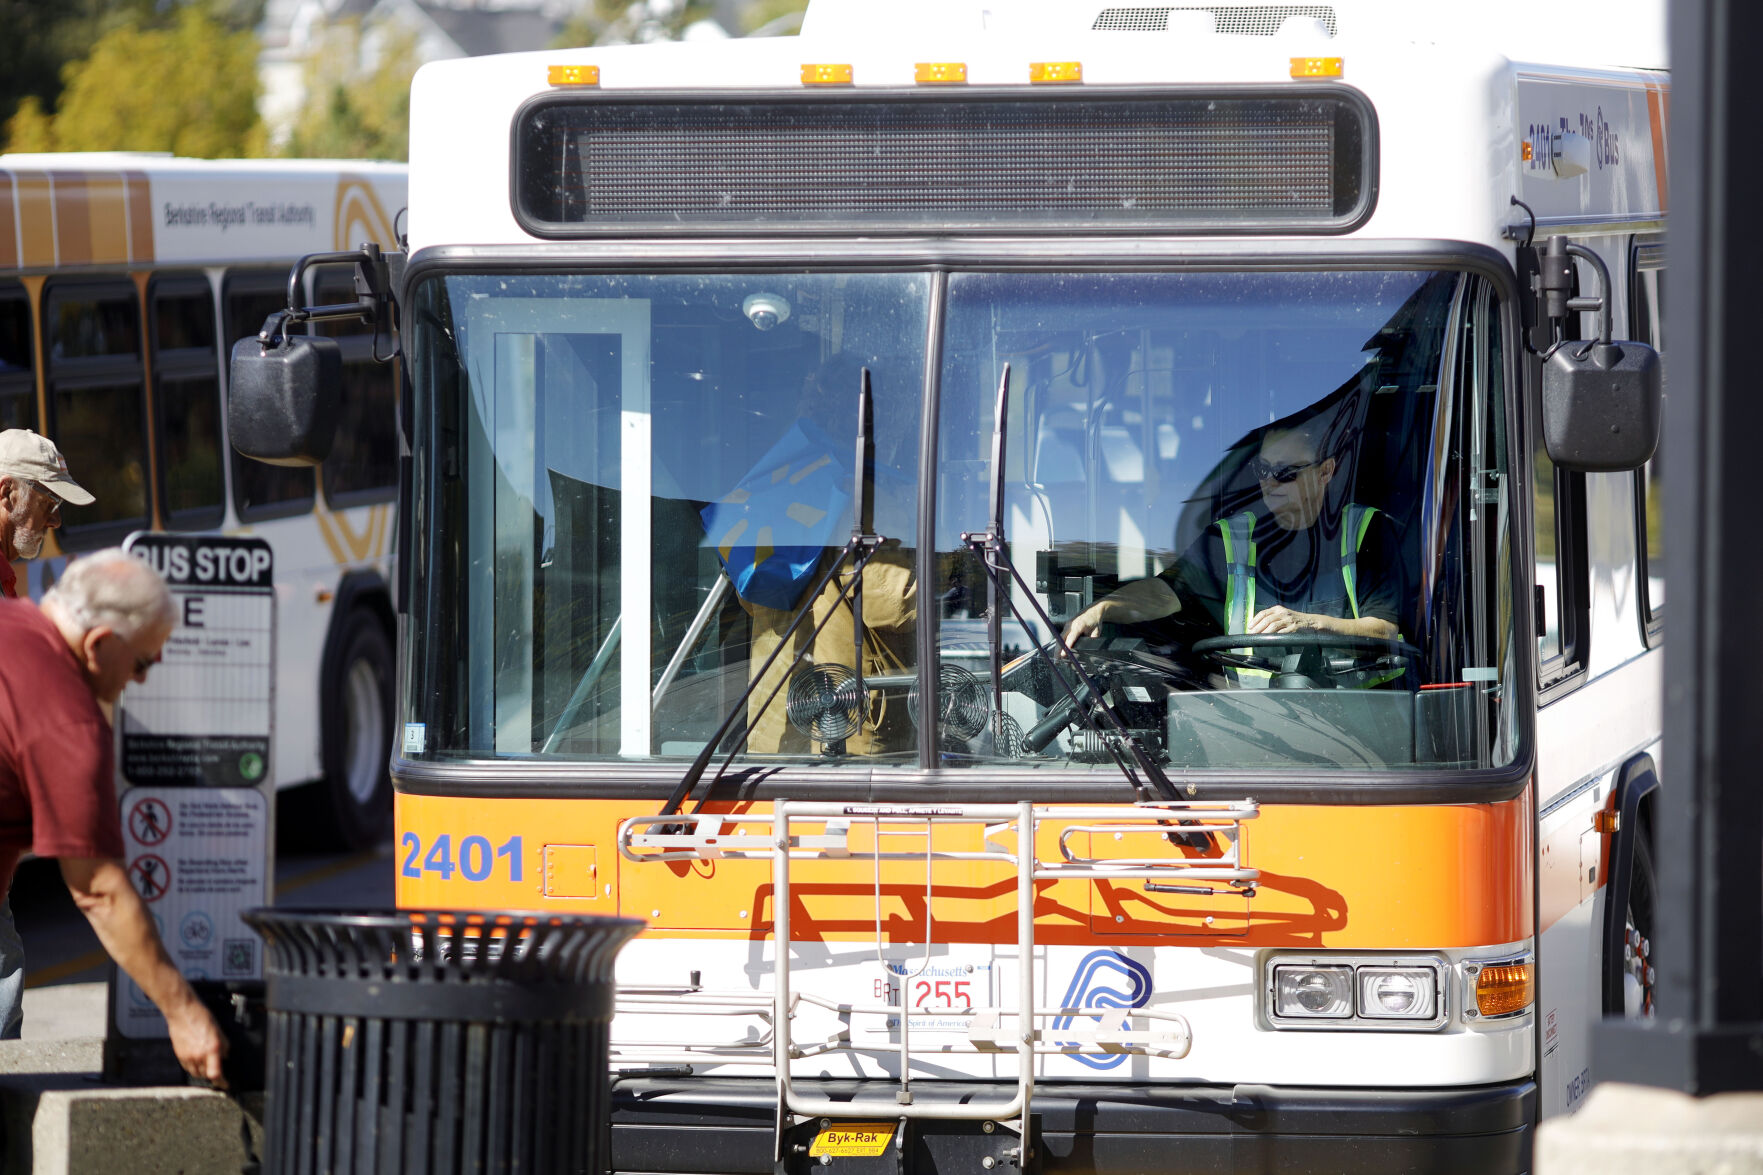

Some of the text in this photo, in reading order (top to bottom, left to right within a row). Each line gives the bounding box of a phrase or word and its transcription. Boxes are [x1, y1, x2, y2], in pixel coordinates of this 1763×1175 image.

[1529, 123, 1551, 171] 2401
[1604, 121, 1620, 166] Bus
[209, 202, 246, 232] Regional
[195, 546, 271, 582] STOP
[183, 597, 205, 628] E
[401, 831, 523, 882] 2401
[915, 980, 971, 1008] 255
[827, 1132, 878, 1145] Byk-Rak
